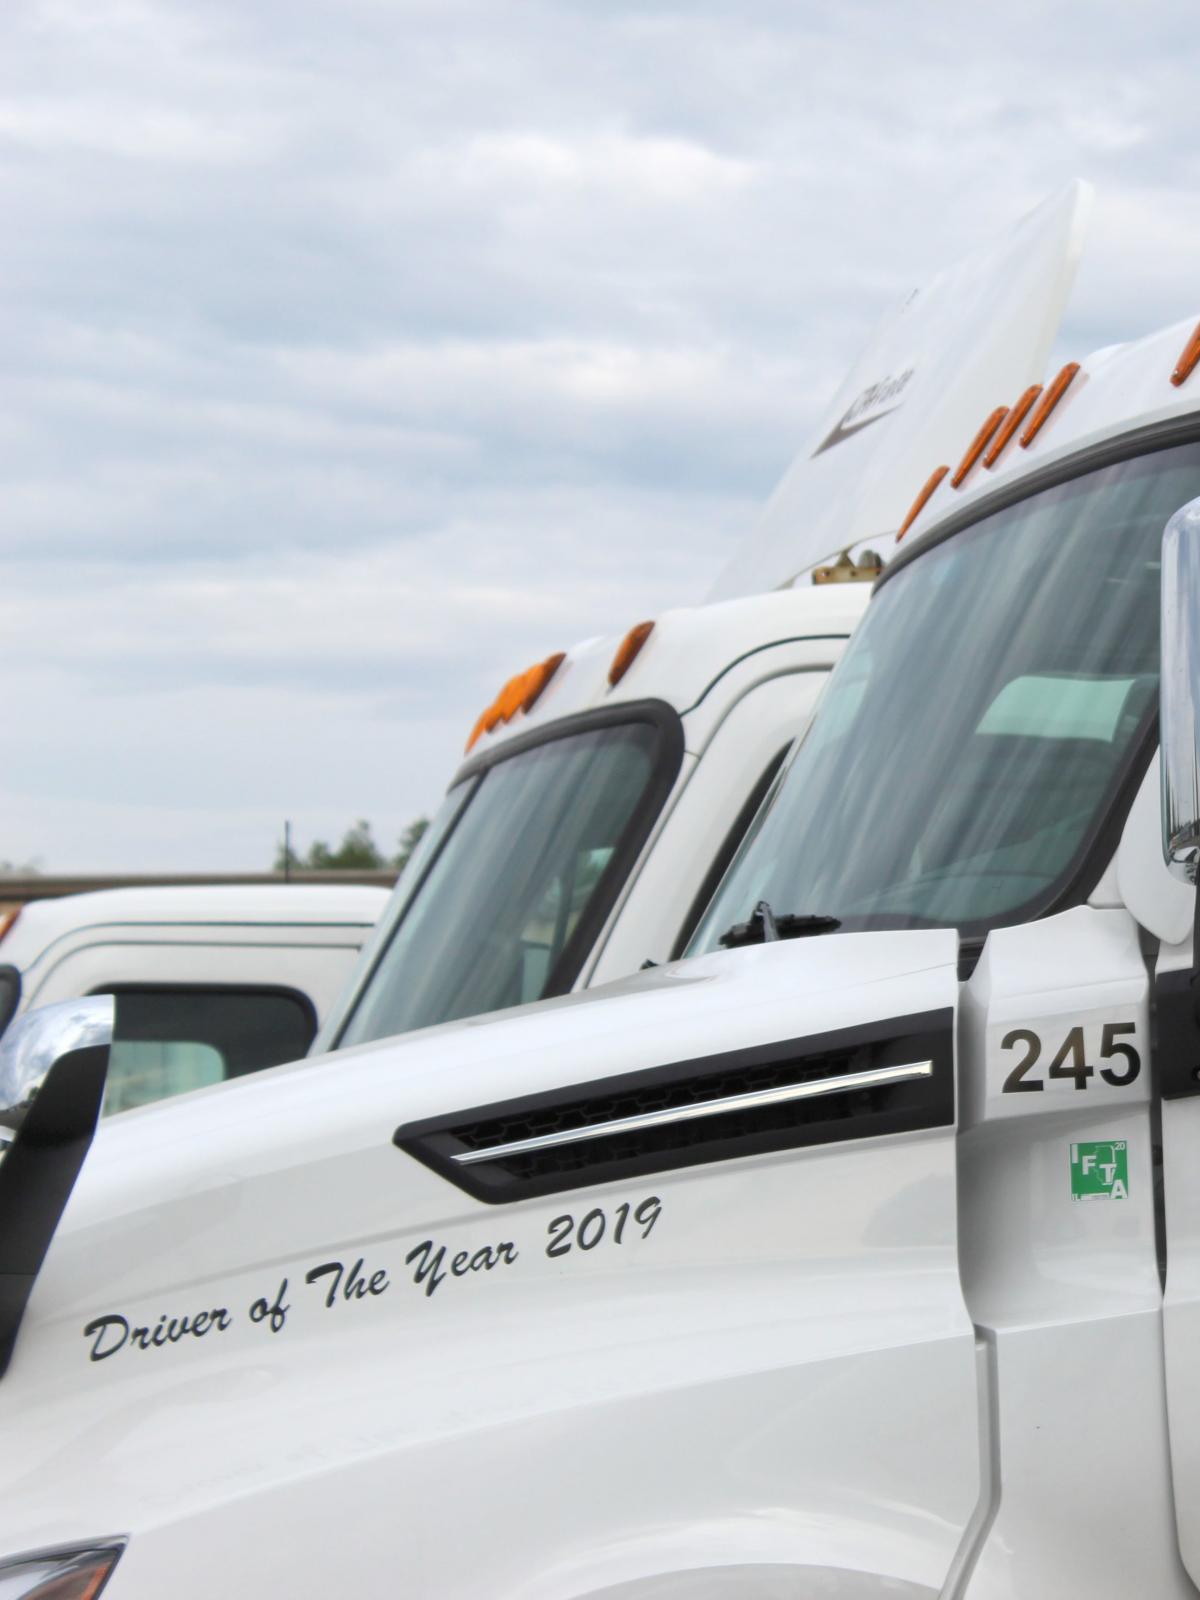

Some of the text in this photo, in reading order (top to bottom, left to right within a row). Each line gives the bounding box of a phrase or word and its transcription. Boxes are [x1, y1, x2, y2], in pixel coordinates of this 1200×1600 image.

[1001, 1022, 1141, 1093] 245
[84, 1195, 663, 1361] Driver of The Year 2019
